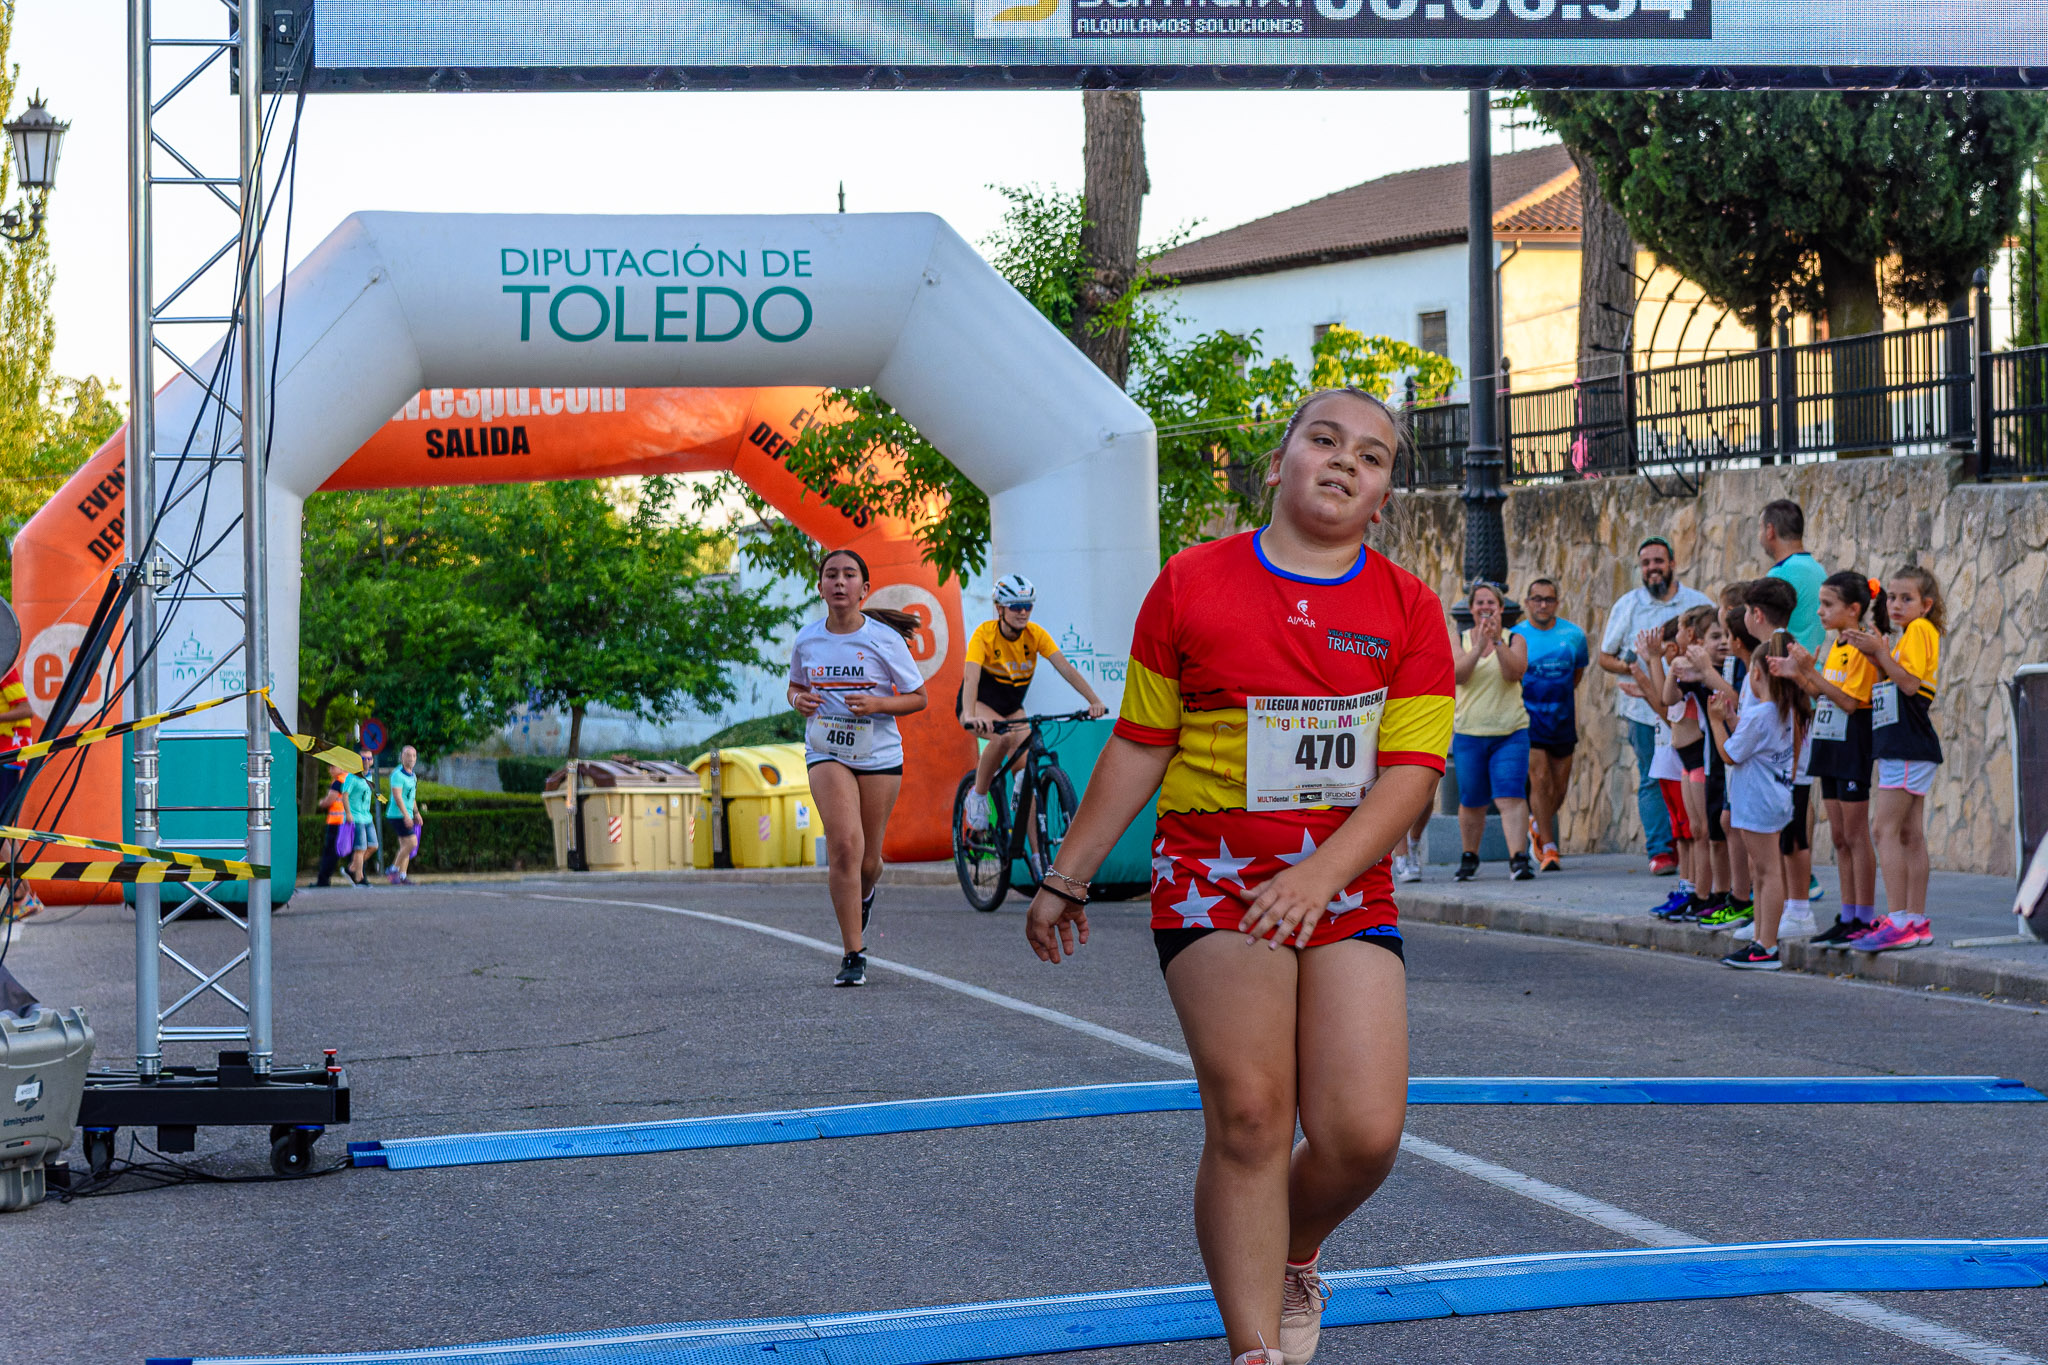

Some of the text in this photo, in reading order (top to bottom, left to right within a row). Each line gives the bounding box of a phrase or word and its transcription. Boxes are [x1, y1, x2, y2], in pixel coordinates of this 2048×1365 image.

[1077, 18, 1304, 34] ALQUILAMOS SOLUCIONES
[500, 243, 813, 278] DIPUTACIÓN DE
[502, 284, 814, 343] TOLEDO
[426, 426, 531, 459] SALIDA
[77, 458, 125, 521] EVEN
[87, 507, 125, 565] DEP
[1344, 631, 1353, 639] DE
[1266, 698, 1299, 711] LEGUA
[1301, 697, 1358, 712] NOCTURNA
[1359, 690, 1384, 709] UGENA
[826, 729, 855, 747] 466
[1295, 732, 1356, 771] 470
[3, 1113, 45, 1127] timingsense
